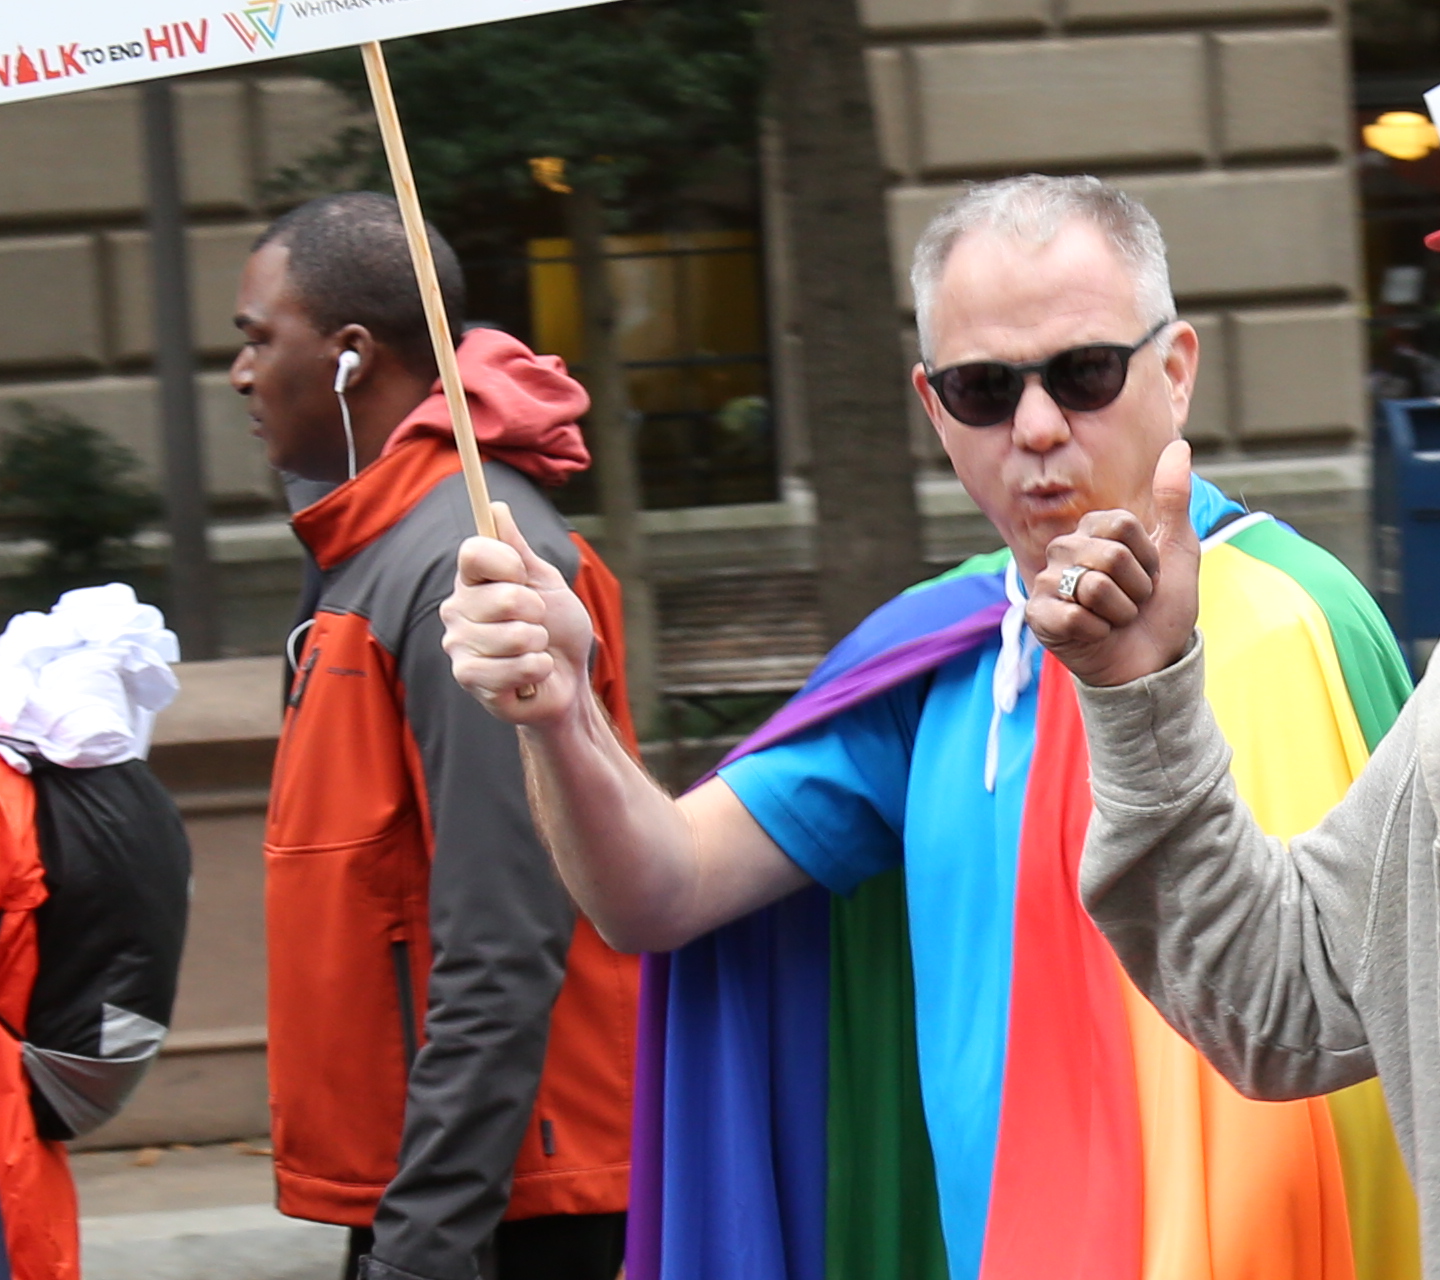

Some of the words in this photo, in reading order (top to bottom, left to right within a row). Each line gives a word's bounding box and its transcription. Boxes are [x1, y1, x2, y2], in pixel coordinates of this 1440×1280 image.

[81, 47, 106, 66] TO
[108, 41, 144, 63] END
[143, 18, 209, 62] HIV
